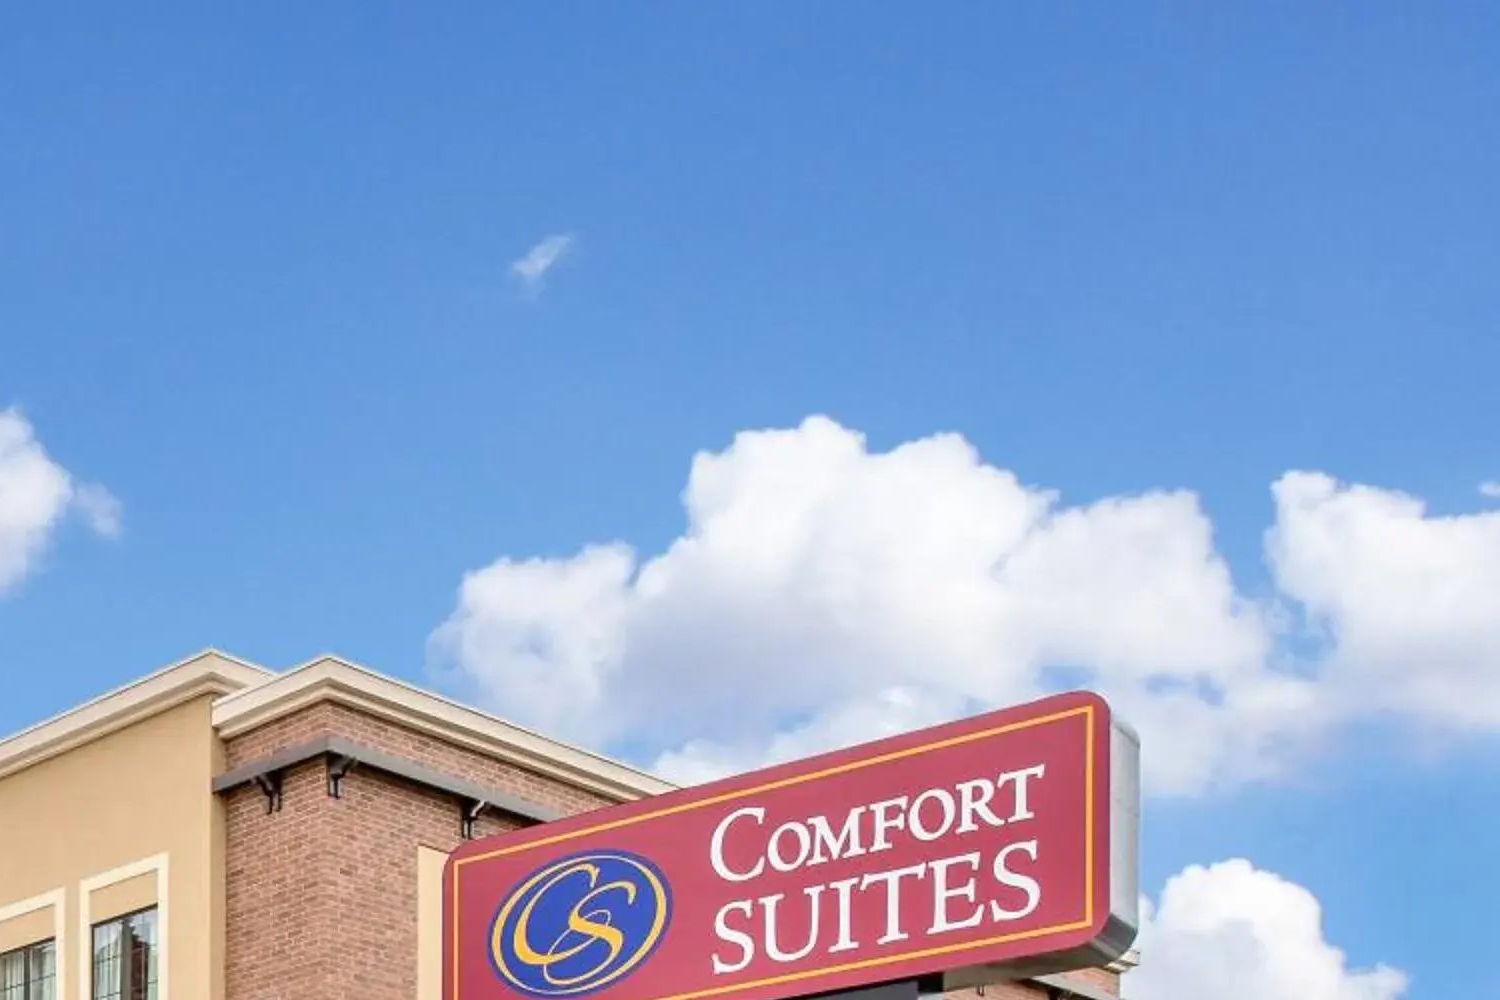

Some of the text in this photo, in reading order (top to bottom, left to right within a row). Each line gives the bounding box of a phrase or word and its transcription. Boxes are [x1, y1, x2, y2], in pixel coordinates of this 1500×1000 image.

[710, 764, 1045, 882] COMFORT
[513, 862, 637, 985] CS
[712, 839, 1041, 976] SUITES
